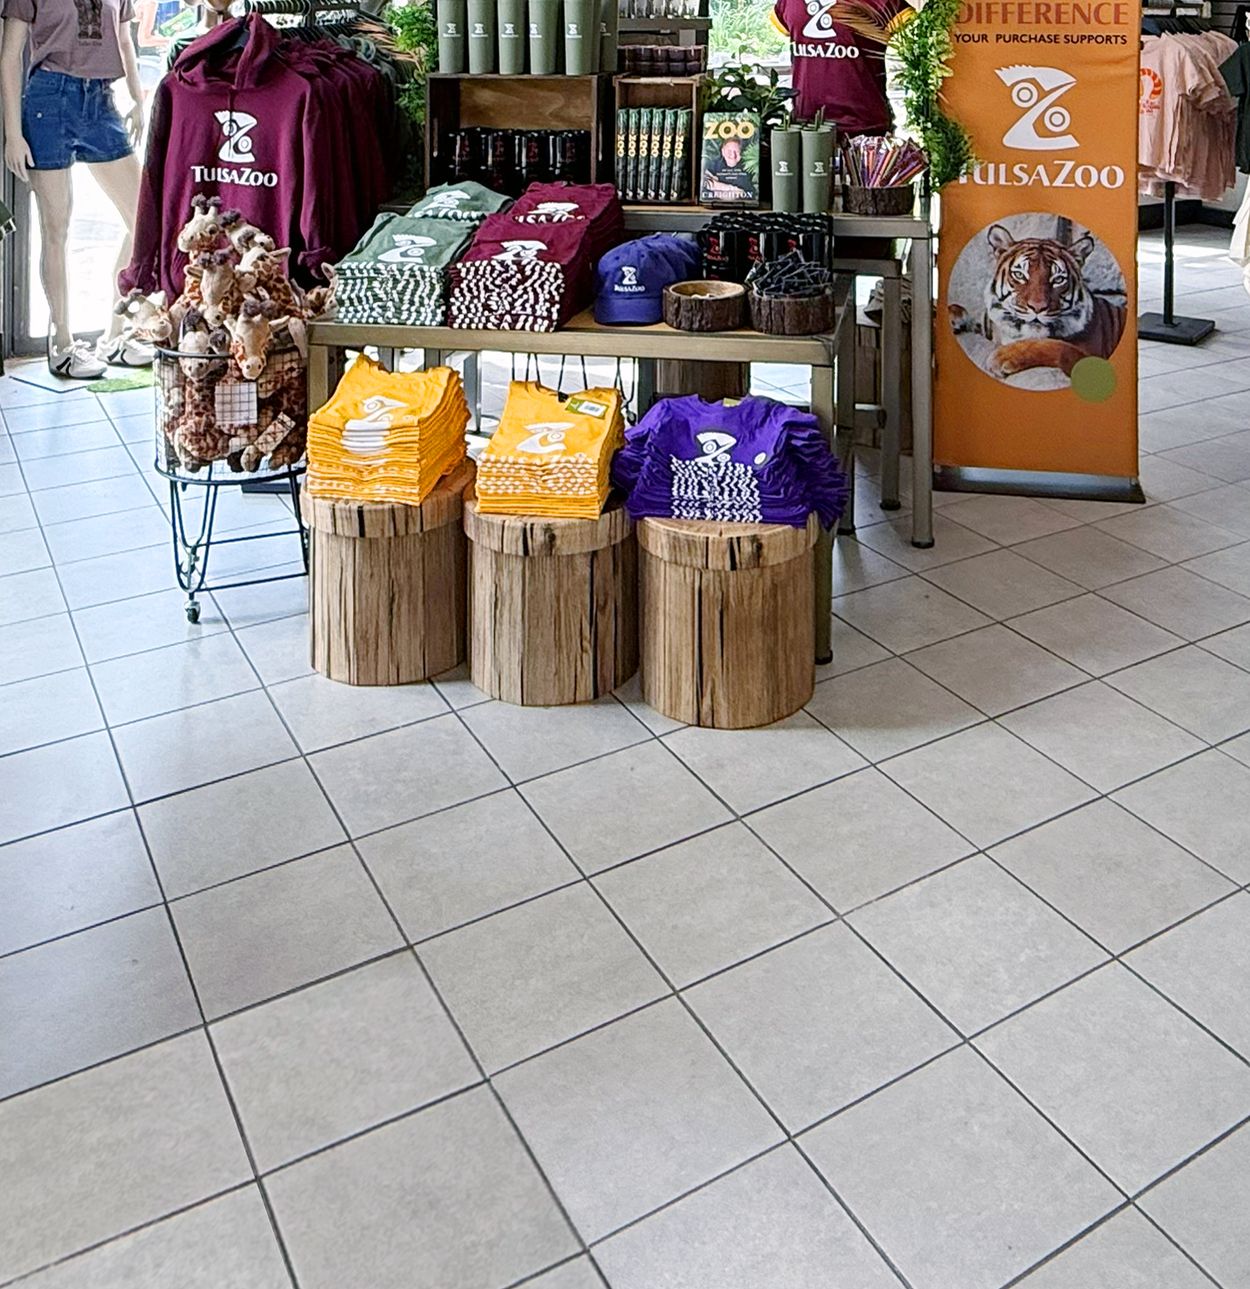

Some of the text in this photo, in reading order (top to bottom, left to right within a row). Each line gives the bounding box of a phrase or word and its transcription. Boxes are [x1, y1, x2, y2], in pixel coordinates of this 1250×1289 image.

[955, 1, 1129, 25] DIFFERENCE
[954, 33, 1127, 45] YOUR PURCHASE SUPPORTS
[703, 121, 756, 140] ZOO
